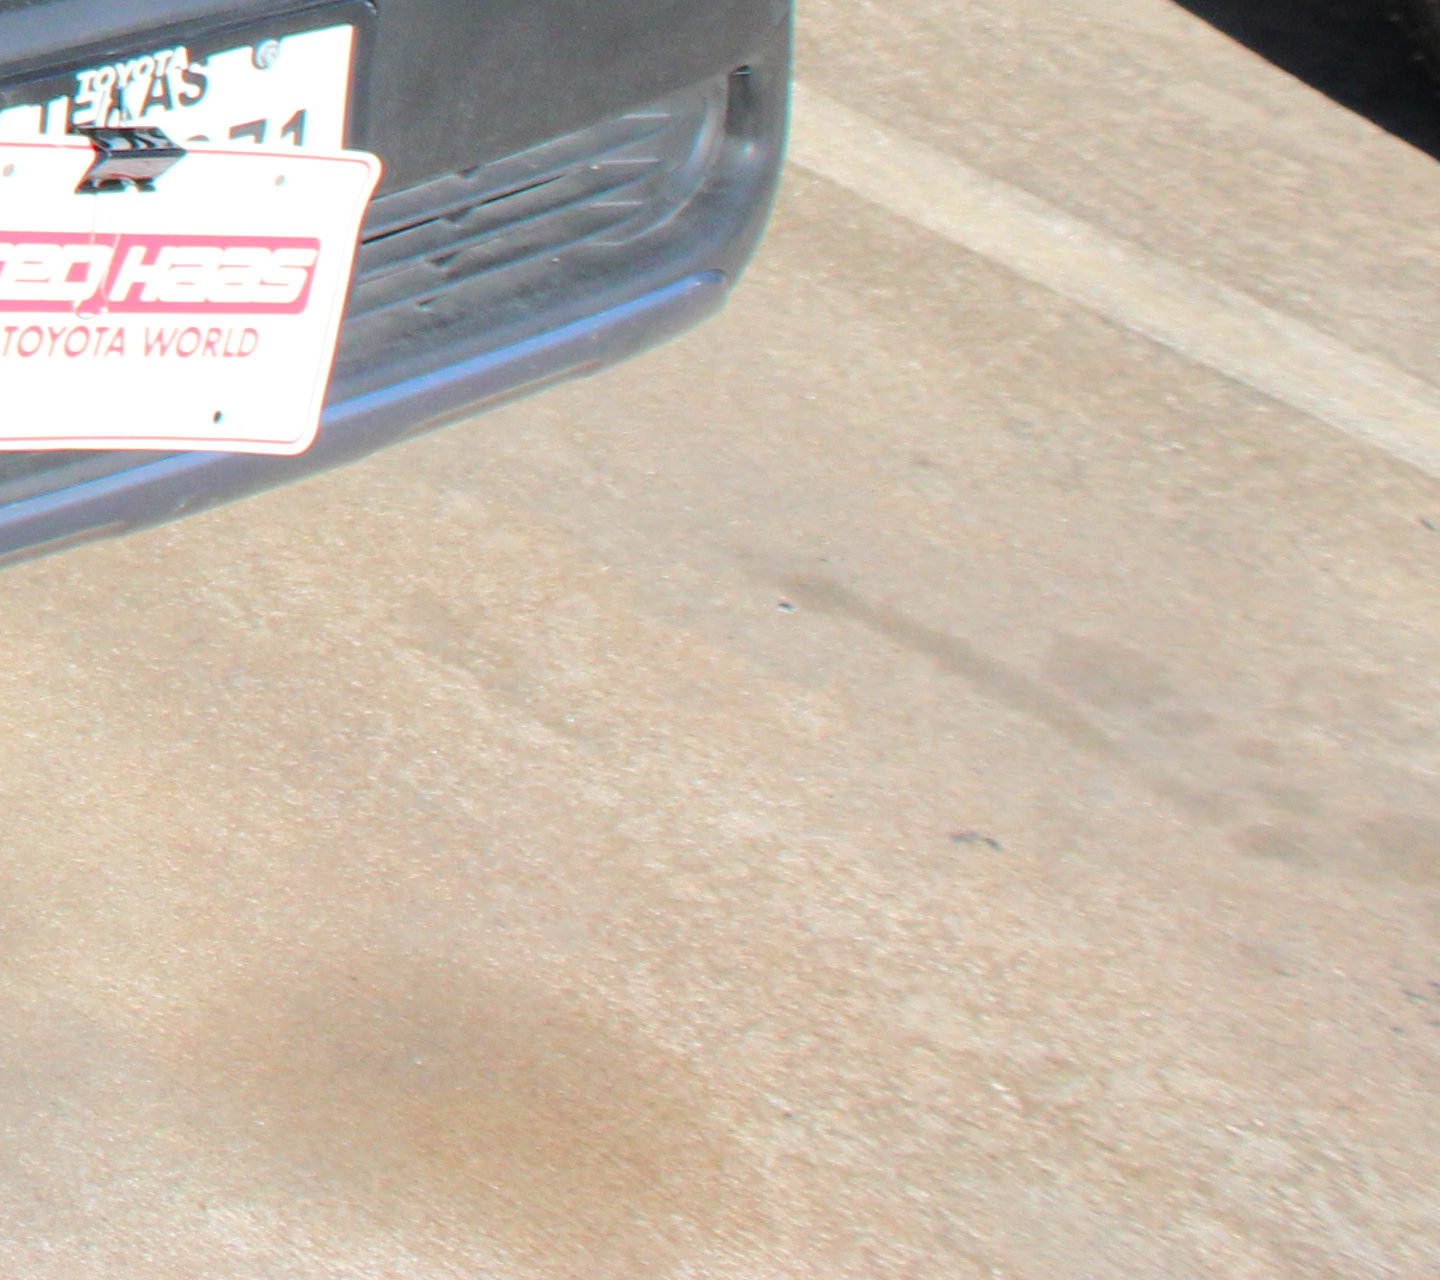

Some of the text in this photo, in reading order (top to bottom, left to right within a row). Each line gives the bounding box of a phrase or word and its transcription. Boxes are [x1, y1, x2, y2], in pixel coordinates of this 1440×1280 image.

[76, 46, 191, 100] TOYOTA
[1, 324, 260, 358] TOYOTA WORLD
